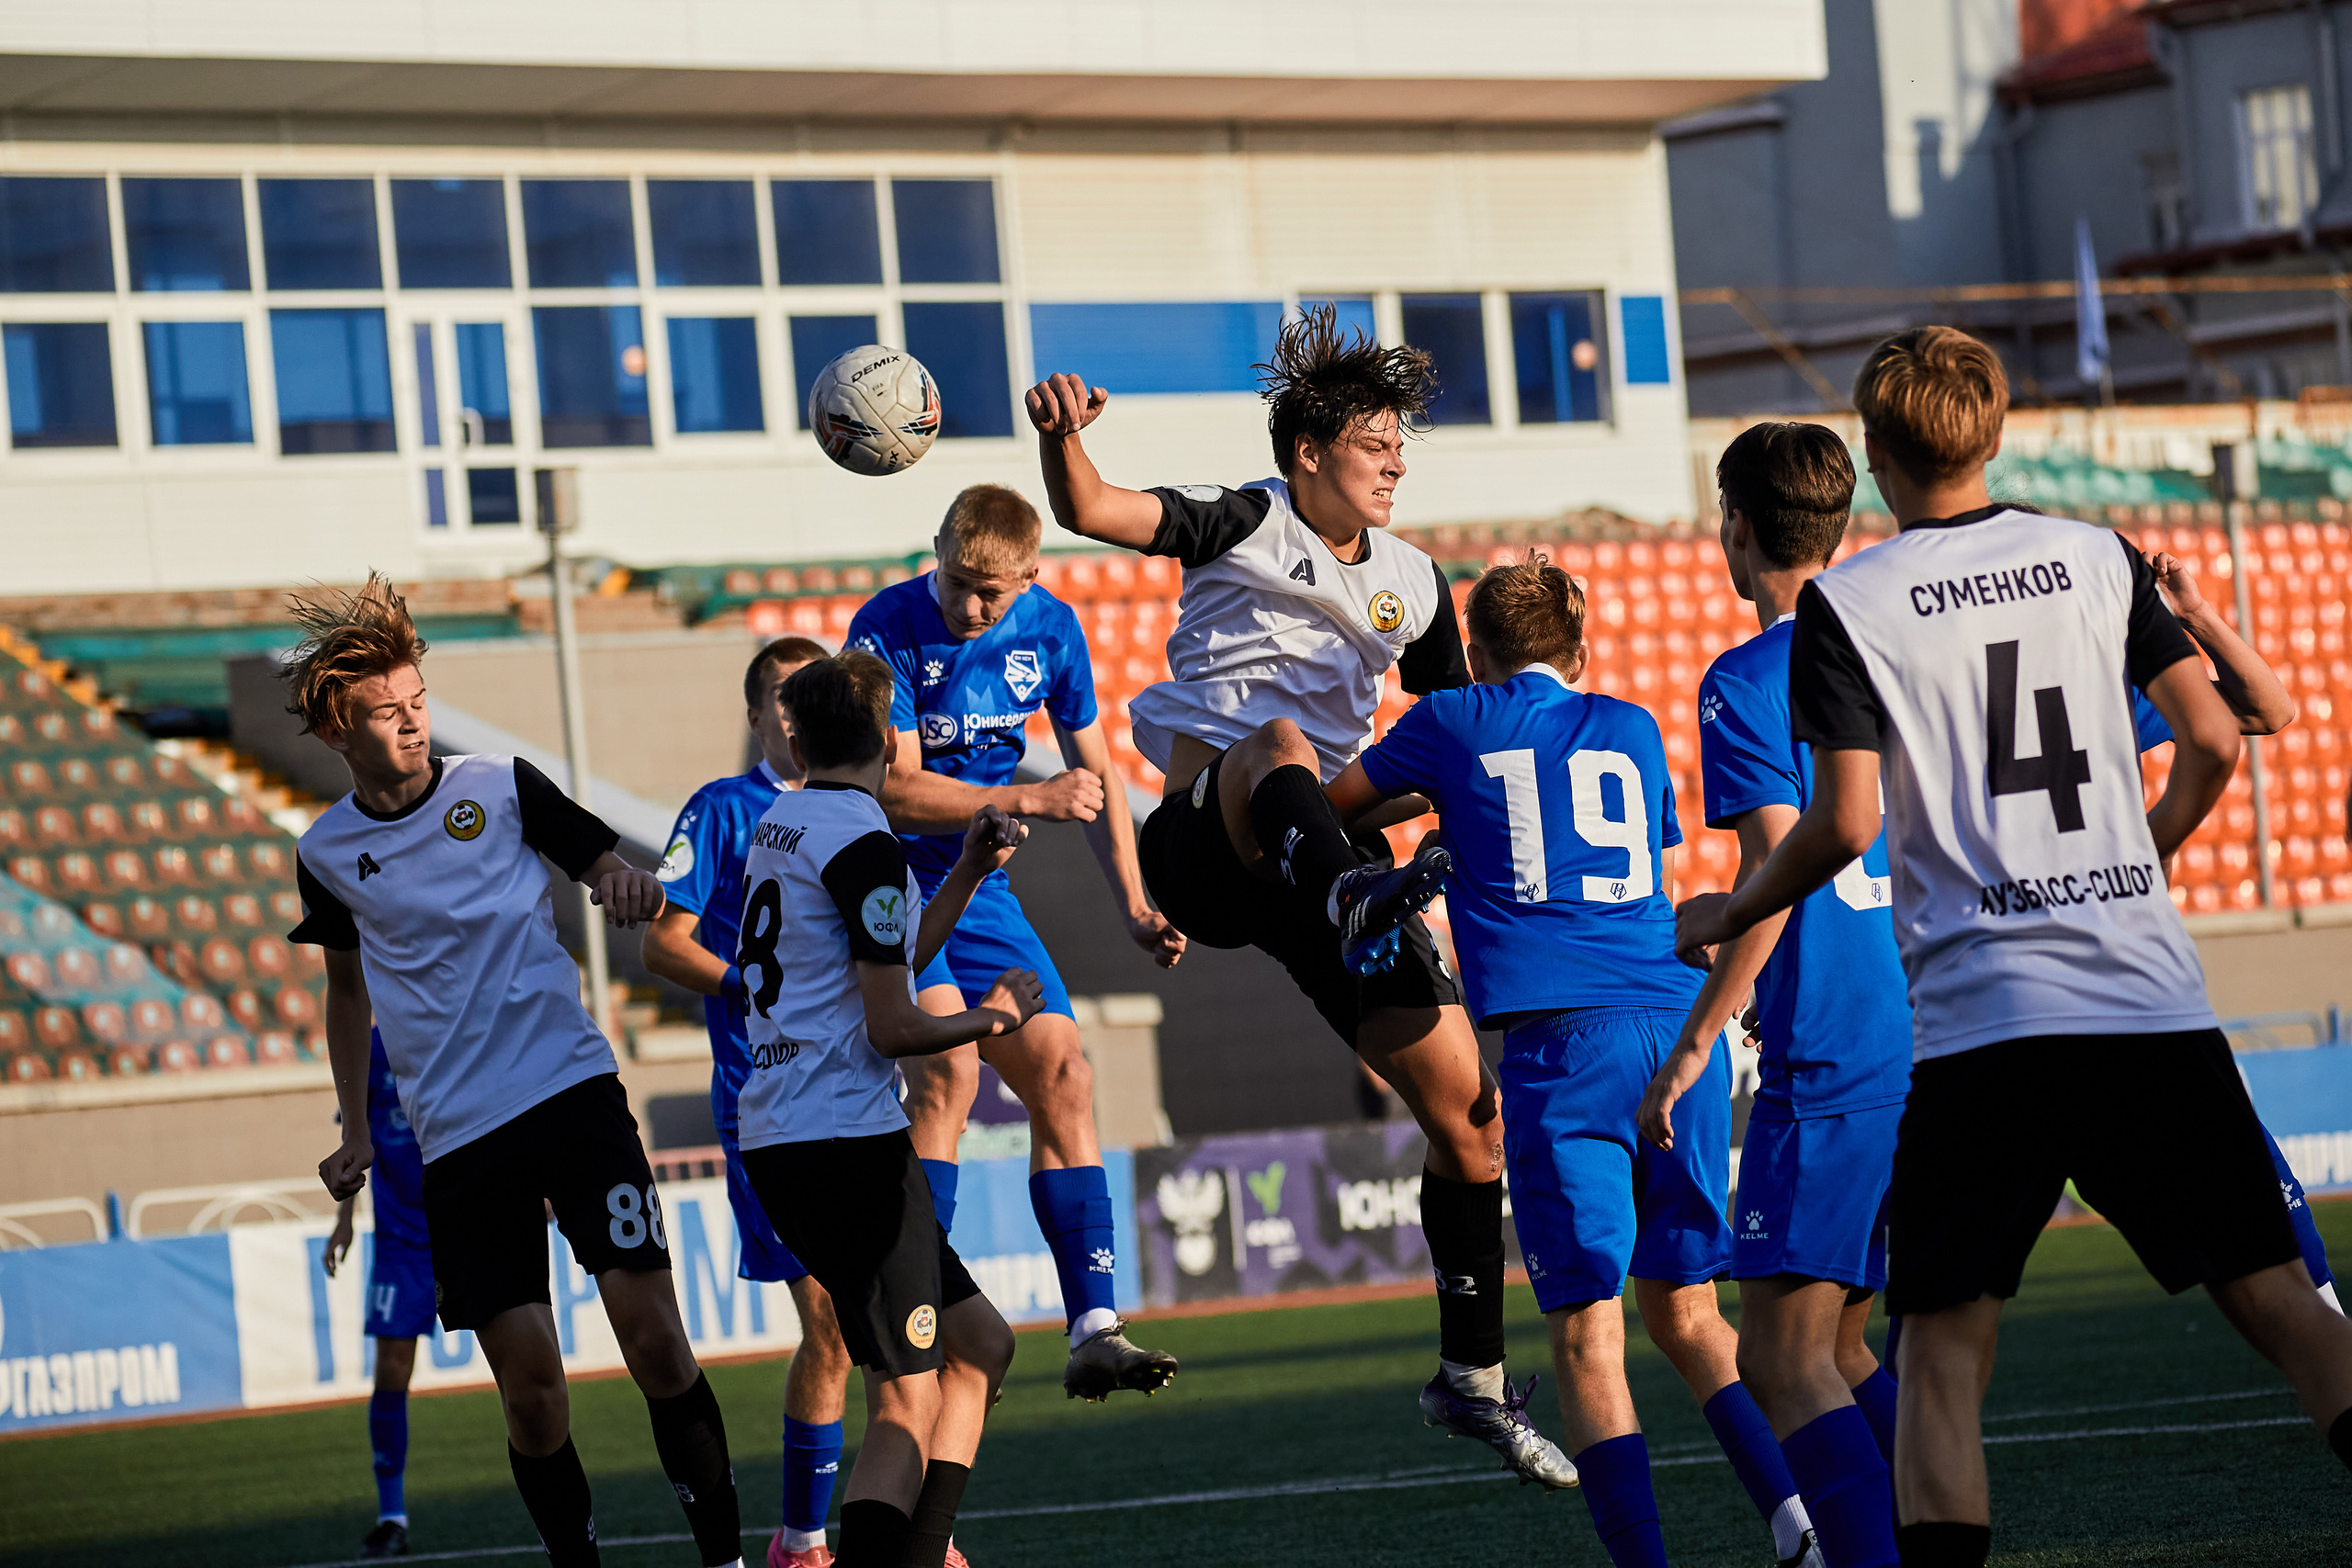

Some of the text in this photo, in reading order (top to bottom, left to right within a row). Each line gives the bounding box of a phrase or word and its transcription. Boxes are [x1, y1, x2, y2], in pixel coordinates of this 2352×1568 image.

[851, 355, 900, 384] DEMIX
[1910, 560, 2073, 617] СУМЕНКОВ
[1985, 639, 2092, 834] 4
[1479, 748, 1653, 903] 19
[606, 1182, 667, 1249] 88
[1740, 1232, 1770, 1241] KELME
